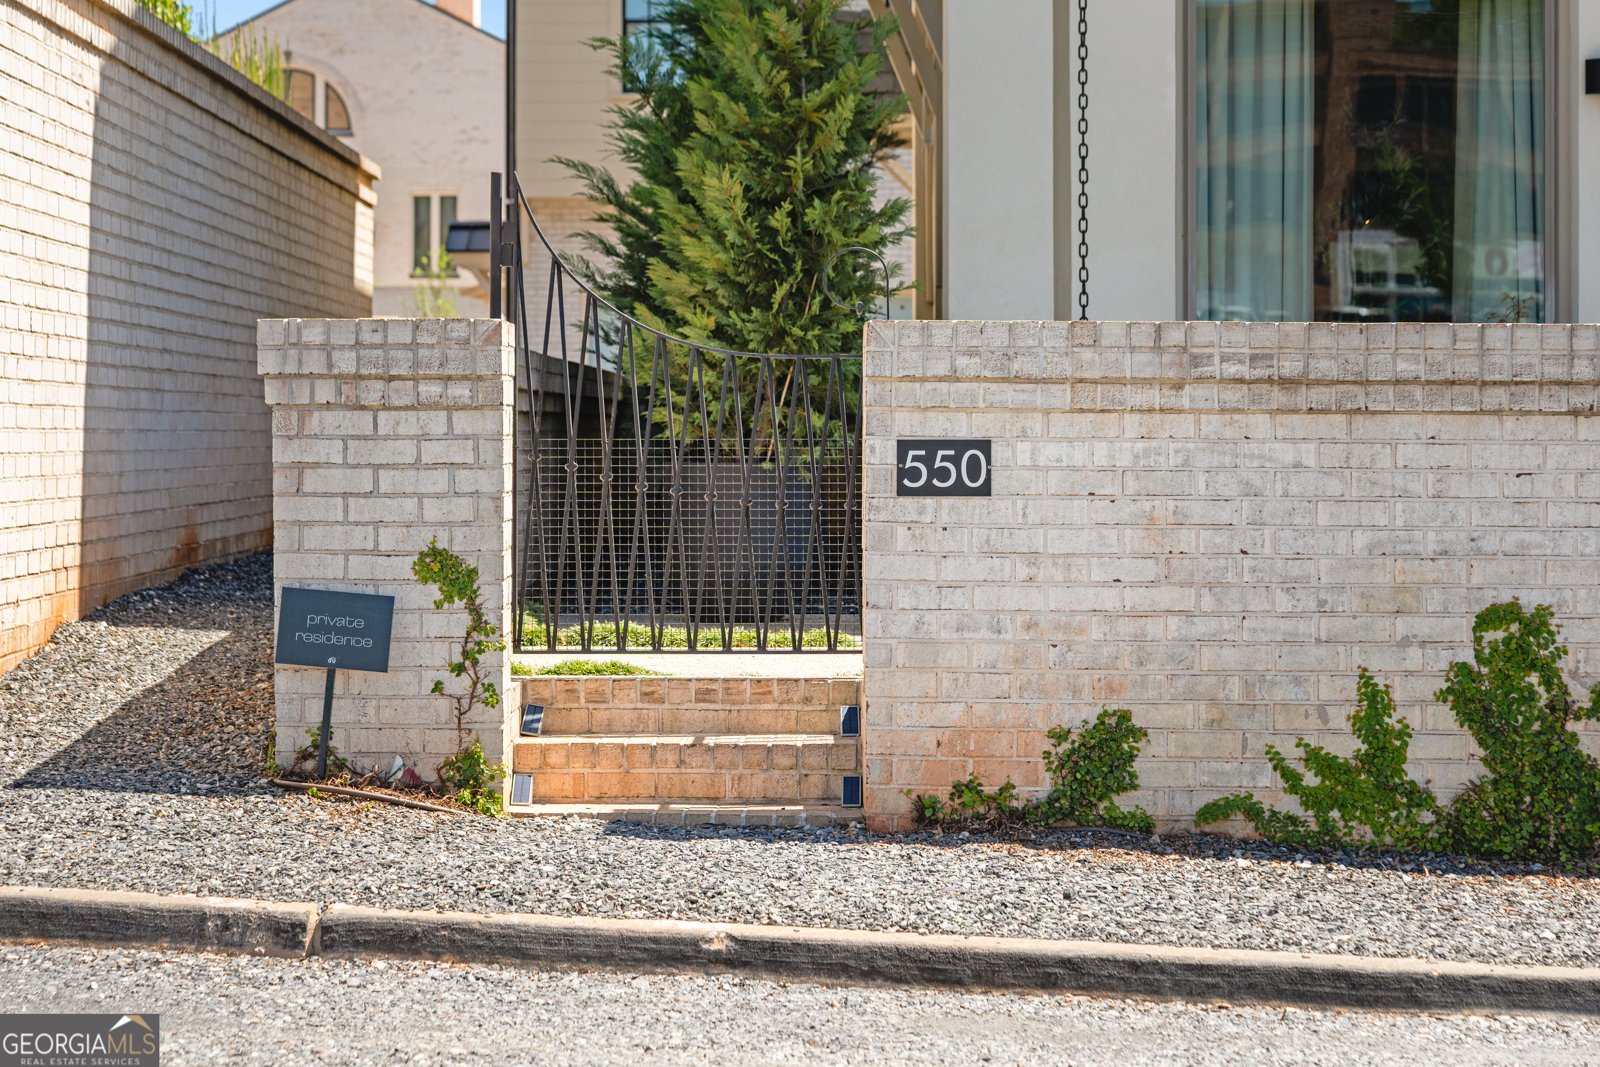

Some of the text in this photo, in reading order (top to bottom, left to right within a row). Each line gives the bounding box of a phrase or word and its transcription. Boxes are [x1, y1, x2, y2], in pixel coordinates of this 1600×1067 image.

[902, 449, 987, 488] 550
[306, 613, 365, 629] private
[295, 631, 373, 648] residence
